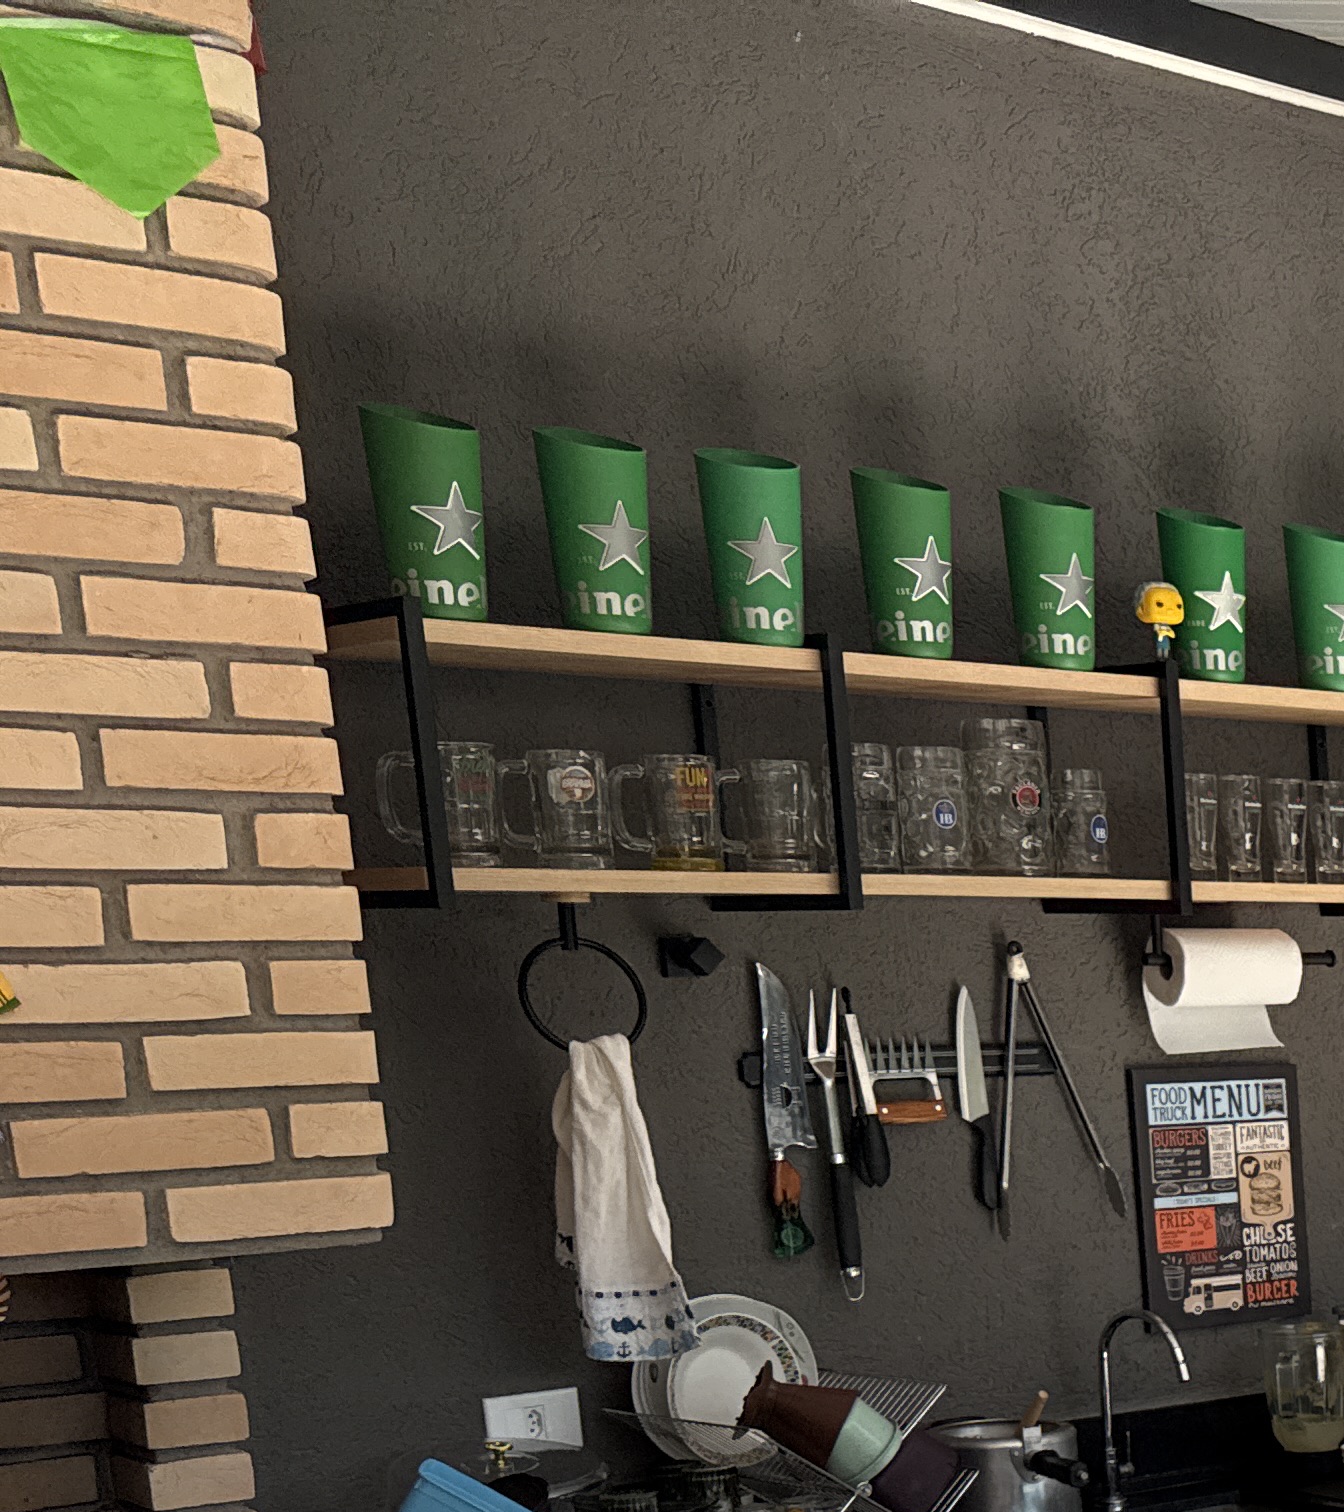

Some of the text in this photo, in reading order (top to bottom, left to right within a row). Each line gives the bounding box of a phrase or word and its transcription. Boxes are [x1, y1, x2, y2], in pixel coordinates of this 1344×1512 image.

[676, 766, 707, 787] FUN
[1150, 1086, 1187, 1106] FOOD
[1188, 1083, 1261, 1120] MENU
[1152, 1106, 1188, 1122] TRUCK
[1152, 1128, 1206, 1148] BURGERS
[1240, 1123, 1285, 1144] FANTASTIC
[1160, 1211, 1196, 1229] FRIES
[1185, 1250, 1218, 1265] DRINKS
[1244, 1242, 1296, 1263] TOMATOS
[1245, 1266, 1268, 1283] BEEF
[1270, 1260, 1298, 1273] ONION
[1246, 1280, 1299, 1303] BURGER
